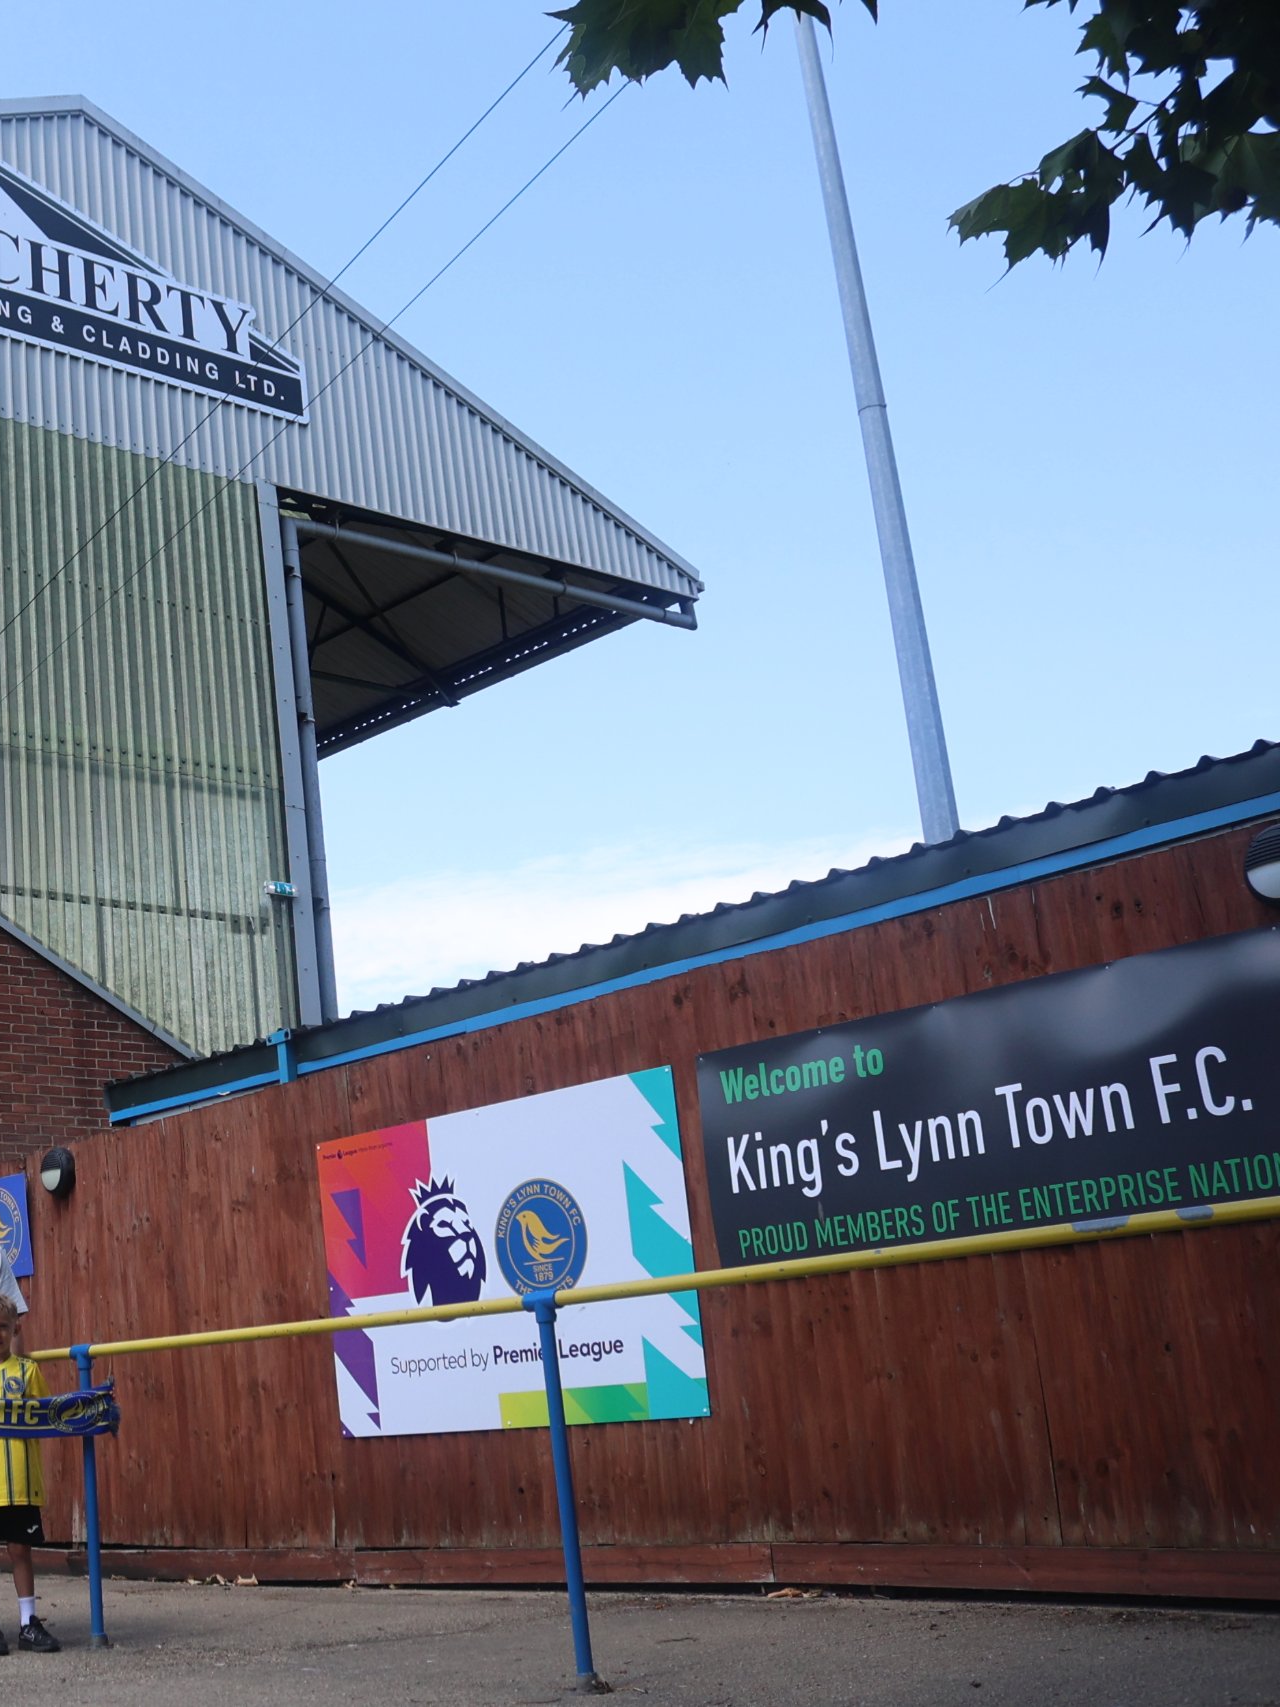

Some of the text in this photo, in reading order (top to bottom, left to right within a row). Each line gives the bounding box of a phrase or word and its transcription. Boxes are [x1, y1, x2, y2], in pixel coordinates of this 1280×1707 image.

[51, 314, 65, 335] &
[82, 323, 221, 381] CLADDING
[233, 371, 286, 400] LTD.
[720, 1045, 884, 1104] Welcome to
[727, 1046, 1253, 1198] King's Lynn Town F.C.
[497, 1183, 581, 1239] KING'S LYNN TOWN FC
[738, 1221, 808, 1259] PROUD
[814, 1205, 925, 1249] MEMBERS
[931, 1199, 961, 1233] OF
[966, 1191, 1014, 1228] THE
[1018, 1167, 1183, 1222] ENTERPRISE
[533, 1263, 553, 1273] SINCE
[534, 1271, 554, 1282] 1879
[390, 1338, 624, 1378] Supported by Premie League
[10, 1400, 40, 1425] FC
